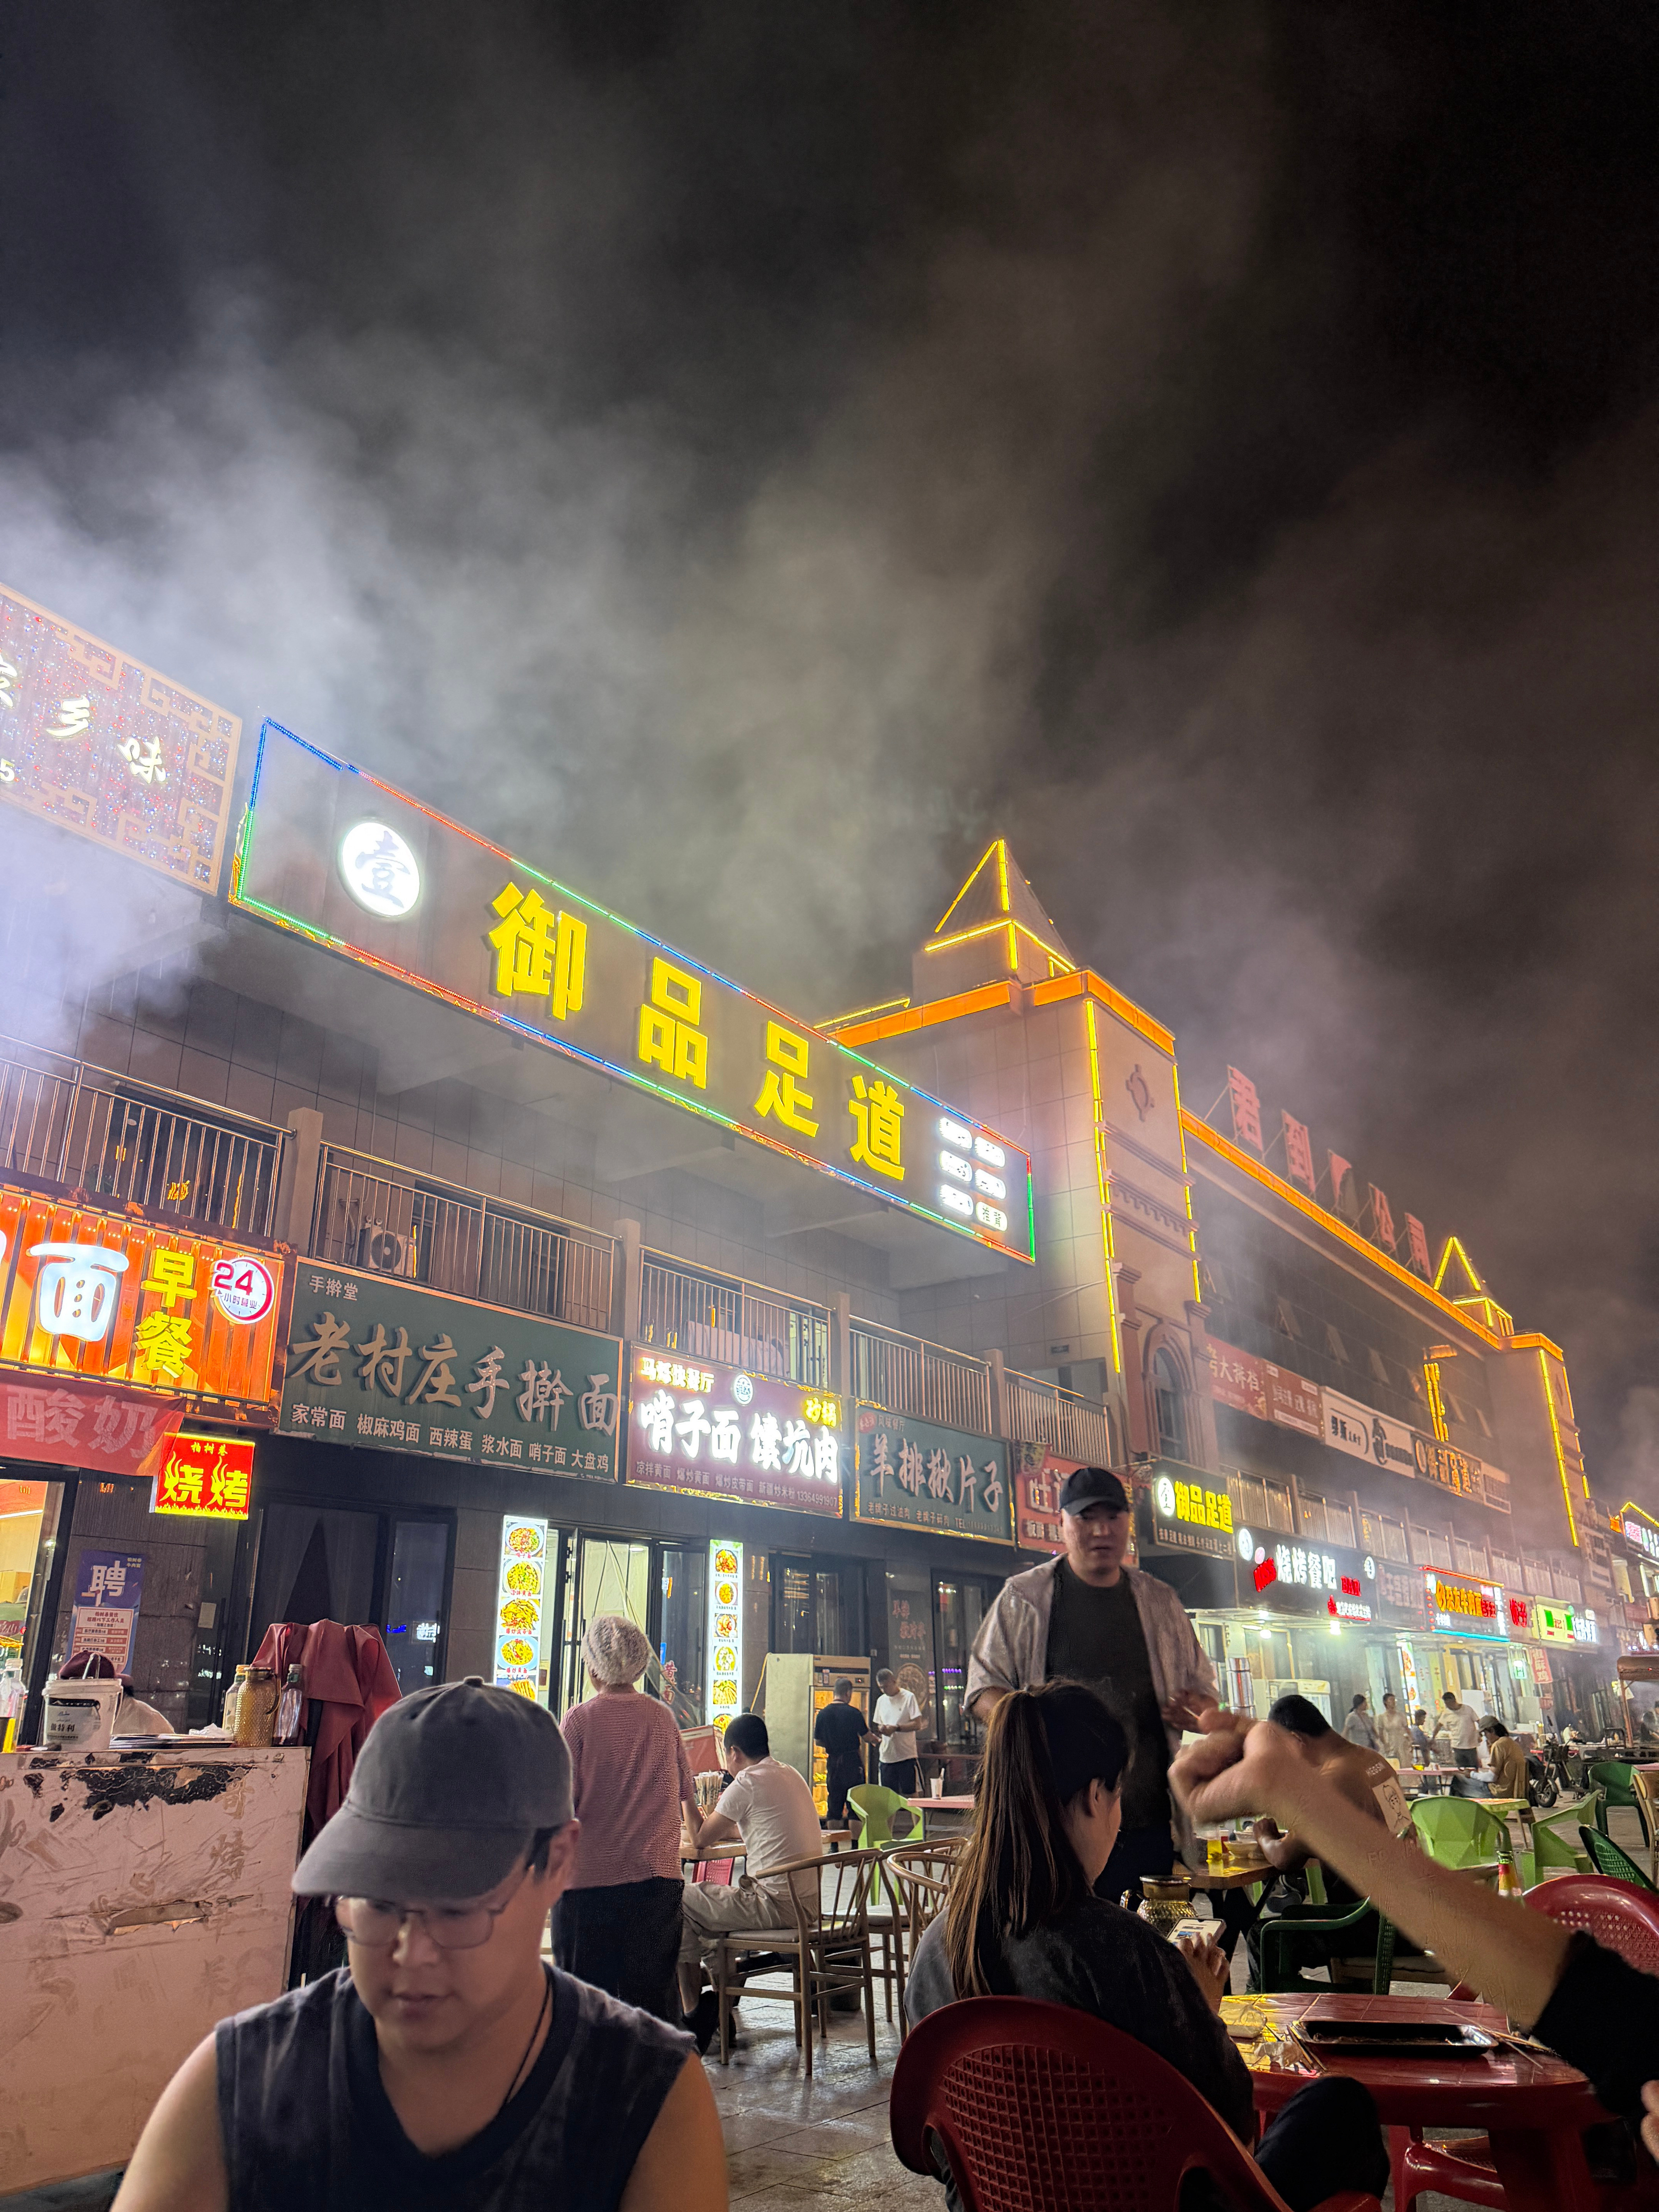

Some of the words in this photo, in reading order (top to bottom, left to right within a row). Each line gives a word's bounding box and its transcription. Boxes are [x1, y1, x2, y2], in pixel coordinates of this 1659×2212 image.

[488, 882, 905, 1181] 御品足道
[0, 1230, 129, 1342] 面
[214, 1262, 254, 1296] 24
[224, 1293, 258, 1309] 小时营业
[309, 1274, 359, 1301] 手擀堂
[136, 1249, 197, 1378] 早餐
[290, 1311, 619, 1436] 老村庄手擀面
[7, 1386, 158, 1459] 酸奶
[191, 1441, 228, 1456] 柏树巷
[291, 1403, 347, 1431] 家常面
[357, 1413, 421, 1443] 椒麻鸡面
[429, 1426, 473, 1451] 西辣蛋
[481, 1434, 523, 1458] 浆水面
[528, 1442, 566, 1466] 哨子面
[571, 1449, 609, 1473] 大盘鸡
[641, 1389, 741, 1464] 哨子面
[750, 1412, 839, 1484] 馕坑肉
[159, 1451, 248, 1508] 烧烤
[636, 1461, 671, 1480] 凉拌黄面
[677, 1467, 710, 1486] 爆炒黄面
[716, 1474, 754, 1493] 爆炒皮带面
[759, 1481, 795, 1499] 新疆炒米粉
[955, 1517, 965, 1529] TEL
[1175, 1481, 1233, 1534] 御品足道
[89, 1560, 127, 1606] 聘
[1276, 1544, 1337, 1589] 烧烤餐吧
